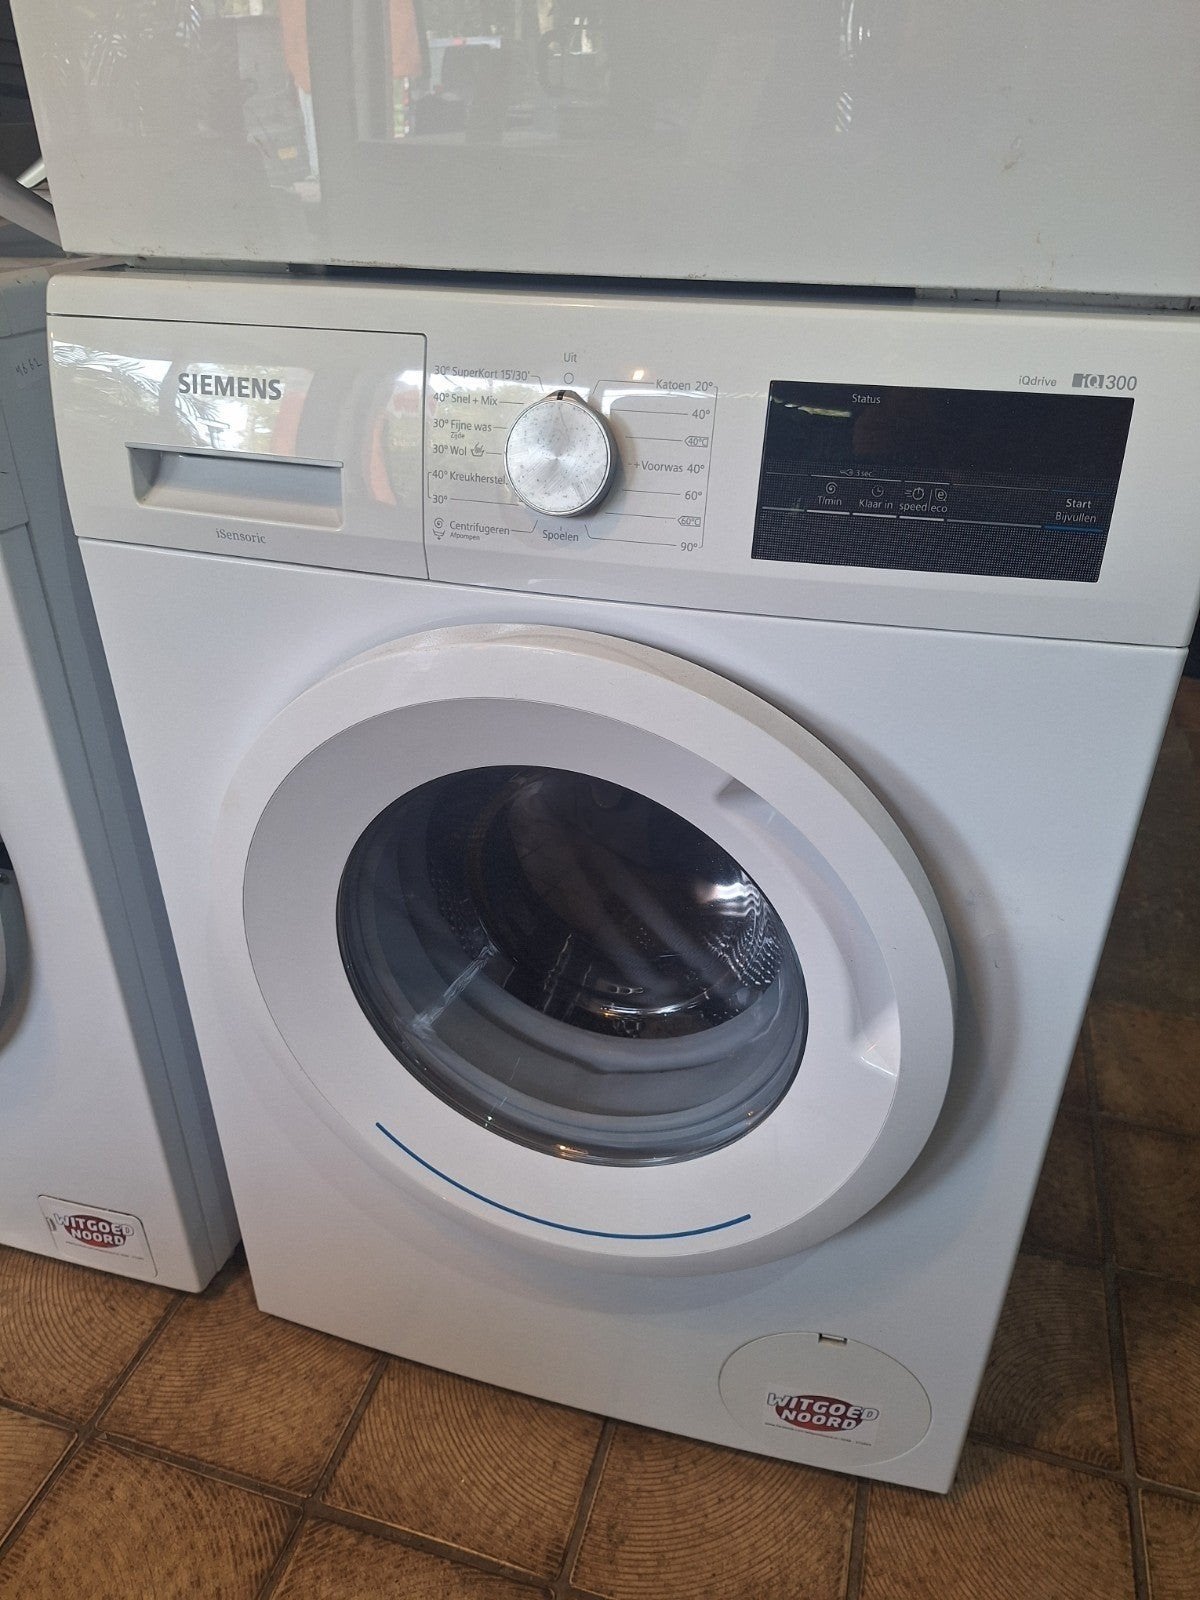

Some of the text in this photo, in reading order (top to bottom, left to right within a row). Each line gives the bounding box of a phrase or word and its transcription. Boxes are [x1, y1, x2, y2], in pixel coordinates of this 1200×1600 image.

[563, 352, 577, 363] Uit
[452, 366, 498, 379] SuperKort
[178, 372, 282, 400] SIEMENS
[656, 380, 691, 391] Katoen
[1018, 375, 1057, 387] iQdrive
[451, 394, 471, 403] Snel
[481, 396, 498, 406] Mix
[852, 393, 881, 404] Status
[692, 409, 711, 420] 40°
[450, 420, 472, 432] Fijne
[474, 423, 492, 432] was
[450, 446, 467, 456] Wol
[432, 494, 448, 504] 30°
[684, 490, 703, 501] 60°
[859, 499, 893, 510] Klaar in
[900, 502, 948, 513] speed eco
[1065, 499, 1092, 510] Start
[1055, 511, 1097, 524] Bijvullen
[449, 520, 510, 536] Centrifugeren
[215, 528, 267, 544] iSensoric
[542, 529, 579, 542] Spoelen
[680, 542, 698, 552] 90°
[54, 1213, 135, 1237] WITGOED
[70, 1228, 127, 1247] NOORD
[766, 1392, 880, 1421] WITGOED
[780, 1409, 858, 1431] NOORD
